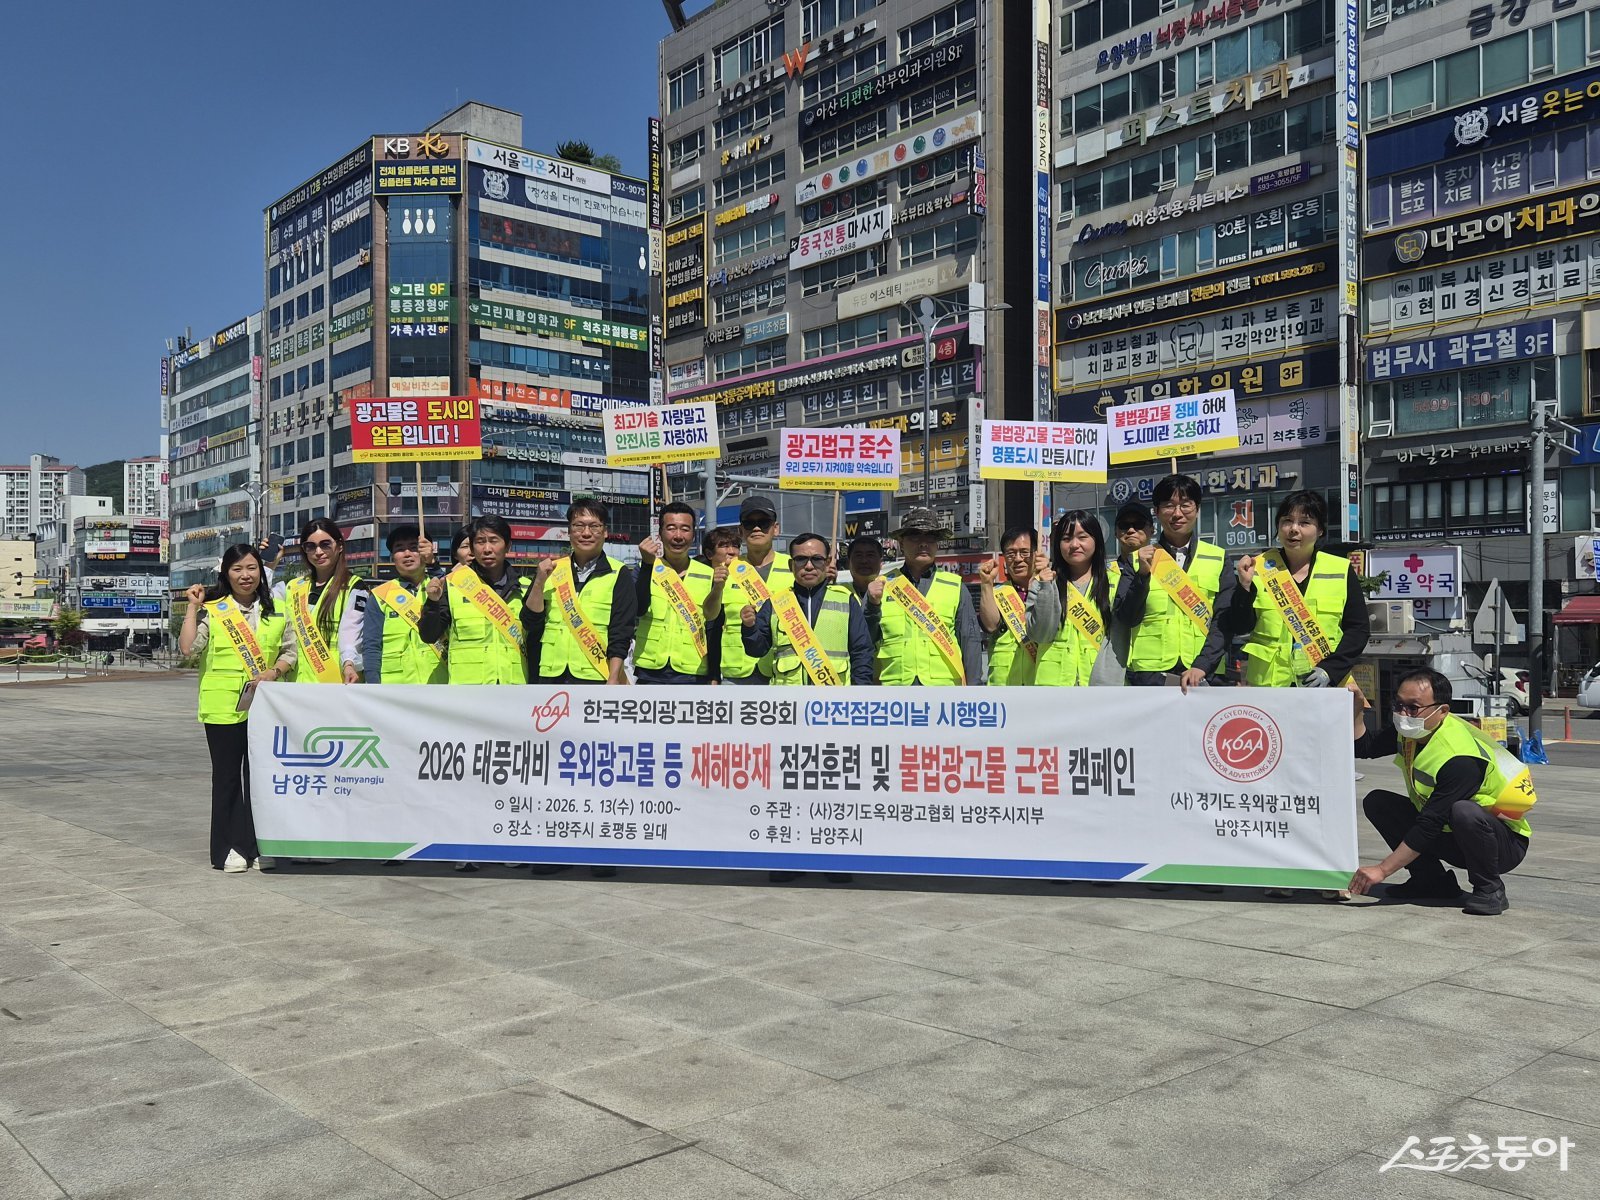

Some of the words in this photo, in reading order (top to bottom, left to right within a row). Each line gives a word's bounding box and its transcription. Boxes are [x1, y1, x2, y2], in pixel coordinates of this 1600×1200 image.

[718, 65, 775, 108] HOTEL
[782, 43, 811, 79] W
[384, 138, 410, 153] KB
[1039, 121, 1047, 167] SEYANG
[379, 166, 396, 176] 전체
[397, 165, 430, 176] 임플란트
[493, 149, 574, 182] 서울리온치과
[1491, 152, 1522, 174] 신경
[379, 177, 412, 188] 임플란트
[413, 176, 438, 187] 재수술
[440, 175, 457, 186] 전문
[612, 180, 646, 196] 592-9075
[1400, 180, 1425, 199] 불소
[1492, 173, 1521, 193] 치료
[1444, 185, 1472, 205] 치료
[1132, 199, 1185, 228] 여성전용
[1217, 217, 1247, 239] 30분
[1255, 208, 1283, 229] 순환
[1291, 198, 1320, 220] 운동
[1400, 199, 1425, 216] 도포
[800, 210, 884, 257] 중국전통마사지
[1346, 170, 1357, 280] 제일한의원
[1218, 253, 1247, 266] FITNESS
[1418, 245, 1580, 293] 매복사랑니발치
[1083, 255, 1150, 288] Curves
[402, 284, 425, 296] 그린
[430, 282, 445, 295] 9F
[869, 282, 902, 302] 에스테틱
[1418, 269, 1581, 317] 현미경신경치료
[390, 299, 437, 313] 통증정형
[481, 303, 559, 328] 그린재활의학과
[563, 317, 577, 330] 9F
[1221, 298, 1325, 330] 치과보존과
[390, 325, 437, 336] 가족사진
[1088, 331, 1158, 358] 치과보철과
[1372, 340, 1436, 378] 법무사
[1448, 327, 1517, 365] 곽근철
[1524, 333, 1549, 355] 3F
[1088, 350, 1158, 375] 치과교정과
[1282, 366, 1300, 380] 3F
[807, 385, 873, 411] 대상포진
[355, 401, 418, 423] 광고물은
[427, 400, 474, 421] 도시의
[614, 411, 659, 431] 최고기술
[661, 407, 706, 426] 자랑말고
[1115, 406, 1171, 428] 불법광고물
[1174, 401, 1198, 420] 정비
[1202, 396, 1226, 416] 하여
[371, 424, 449, 447] 얼굴입니다
[615, 431, 661, 451] 안전시공
[663, 427, 708, 447] 자랑하자
[991, 425, 1049, 444] 불법광고물
[1051, 427, 1099, 446] 근절하여
[1123, 424, 1170, 446] 도시미관
[1173, 418, 1221, 440] 조성하자
[1273, 425, 1321, 443] 척추통증
[787, 434, 855, 459] 광고법규
[859, 434, 894, 459] 준수
[992, 446, 1038, 465] 명품도시
[786, 462, 800, 473] 우리
[801, 462, 824, 474] 모두가
[825, 462, 855, 474] 지켜야할
[856, 462, 894, 474] 약속입니다
[487, 487, 559, 501] 디지털프라임치과의원
[1229, 500, 1254, 528] 치
[845, 523, 858, 536] W
[1414, 600, 1431, 617] 약
[583, 698, 734, 726] 한국옥외광고협회
[739, 700, 798, 726] 중앙회
[804, 700, 931, 729] (안전점검의날
[936, 700, 1008, 729] 시행일)
[1223, 709, 1261, 720] GYEONGGI
[418, 740, 465, 782] 2026
[472, 739, 550, 786] 태풍대비
[557, 740, 656, 788] 옥외광고물
[663, 742, 683, 789] 등
[691, 742, 772, 790] 재해방재
[779, 743, 862, 792] 점검훈련
[870, 744, 890, 792] 및
[899, 744, 1007, 795] 불법광고물
[1014, 746, 1060, 796] 근절
[1068, 747, 1136, 797] 캠페인
[272, 773, 328, 795] 남양주
[334, 774, 385, 785] Namyangju
[333, 786, 352, 797] City
[509, 796, 534, 814] 일시
[545, 799, 579, 814] 2026.
[600, 797, 635, 817] 13(수)
[765, 801, 795, 819] 주관
[809, 803, 955, 824] (사)경기도옥외광고협회
[960, 805, 1045, 826] 남양주시지부
[508, 821, 532, 838] 장소
[545, 820, 594, 839] 남양주시
[599, 822, 638, 840] 호평동
[643, 823, 668, 841] 일대
[765, 826, 792, 844] 후원
[810, 827, 864, 846] 남양주시
[1214, 819, 1290, 838] 남양주시지부
